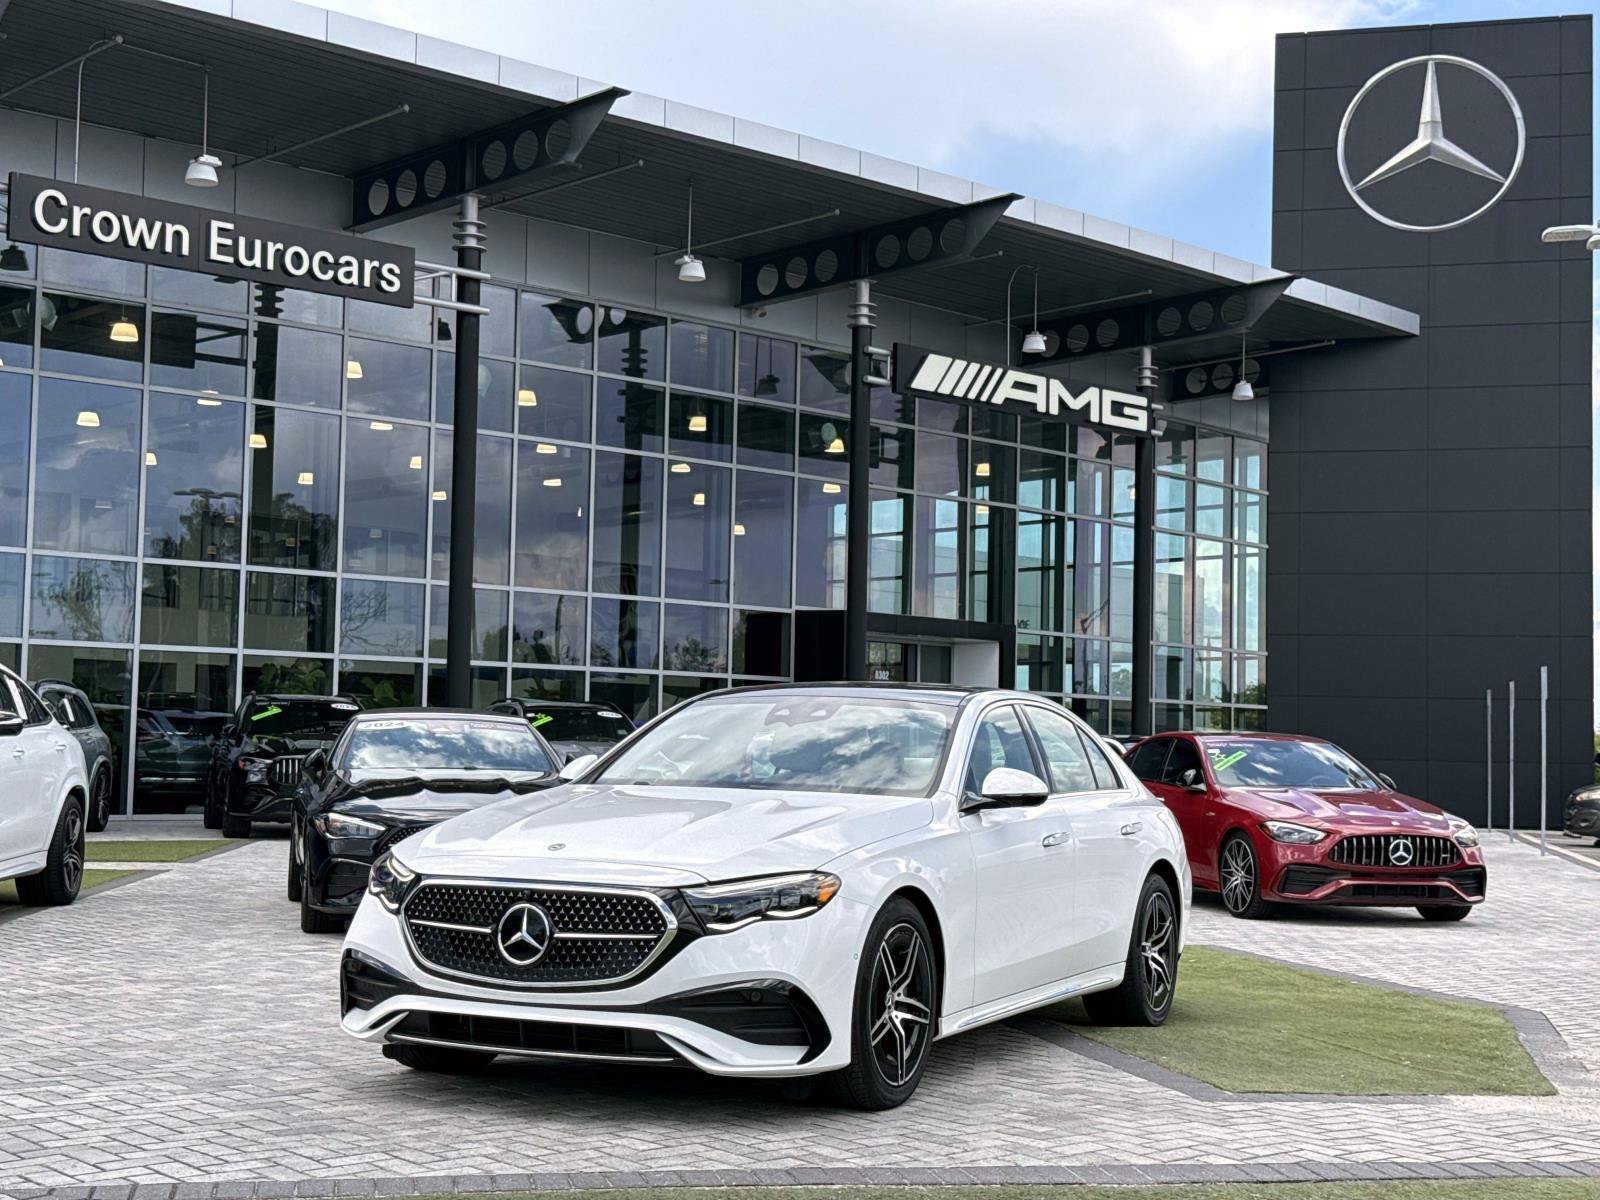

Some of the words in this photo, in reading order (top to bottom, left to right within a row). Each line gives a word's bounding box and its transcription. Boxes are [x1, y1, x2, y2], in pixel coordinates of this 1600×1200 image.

[33, 188, 191, 257] Crown
[208, 219, 402, 293] Eurocars
[989, 369, 1148, 432] AMG
[361, 721, 405, 729] 2024
